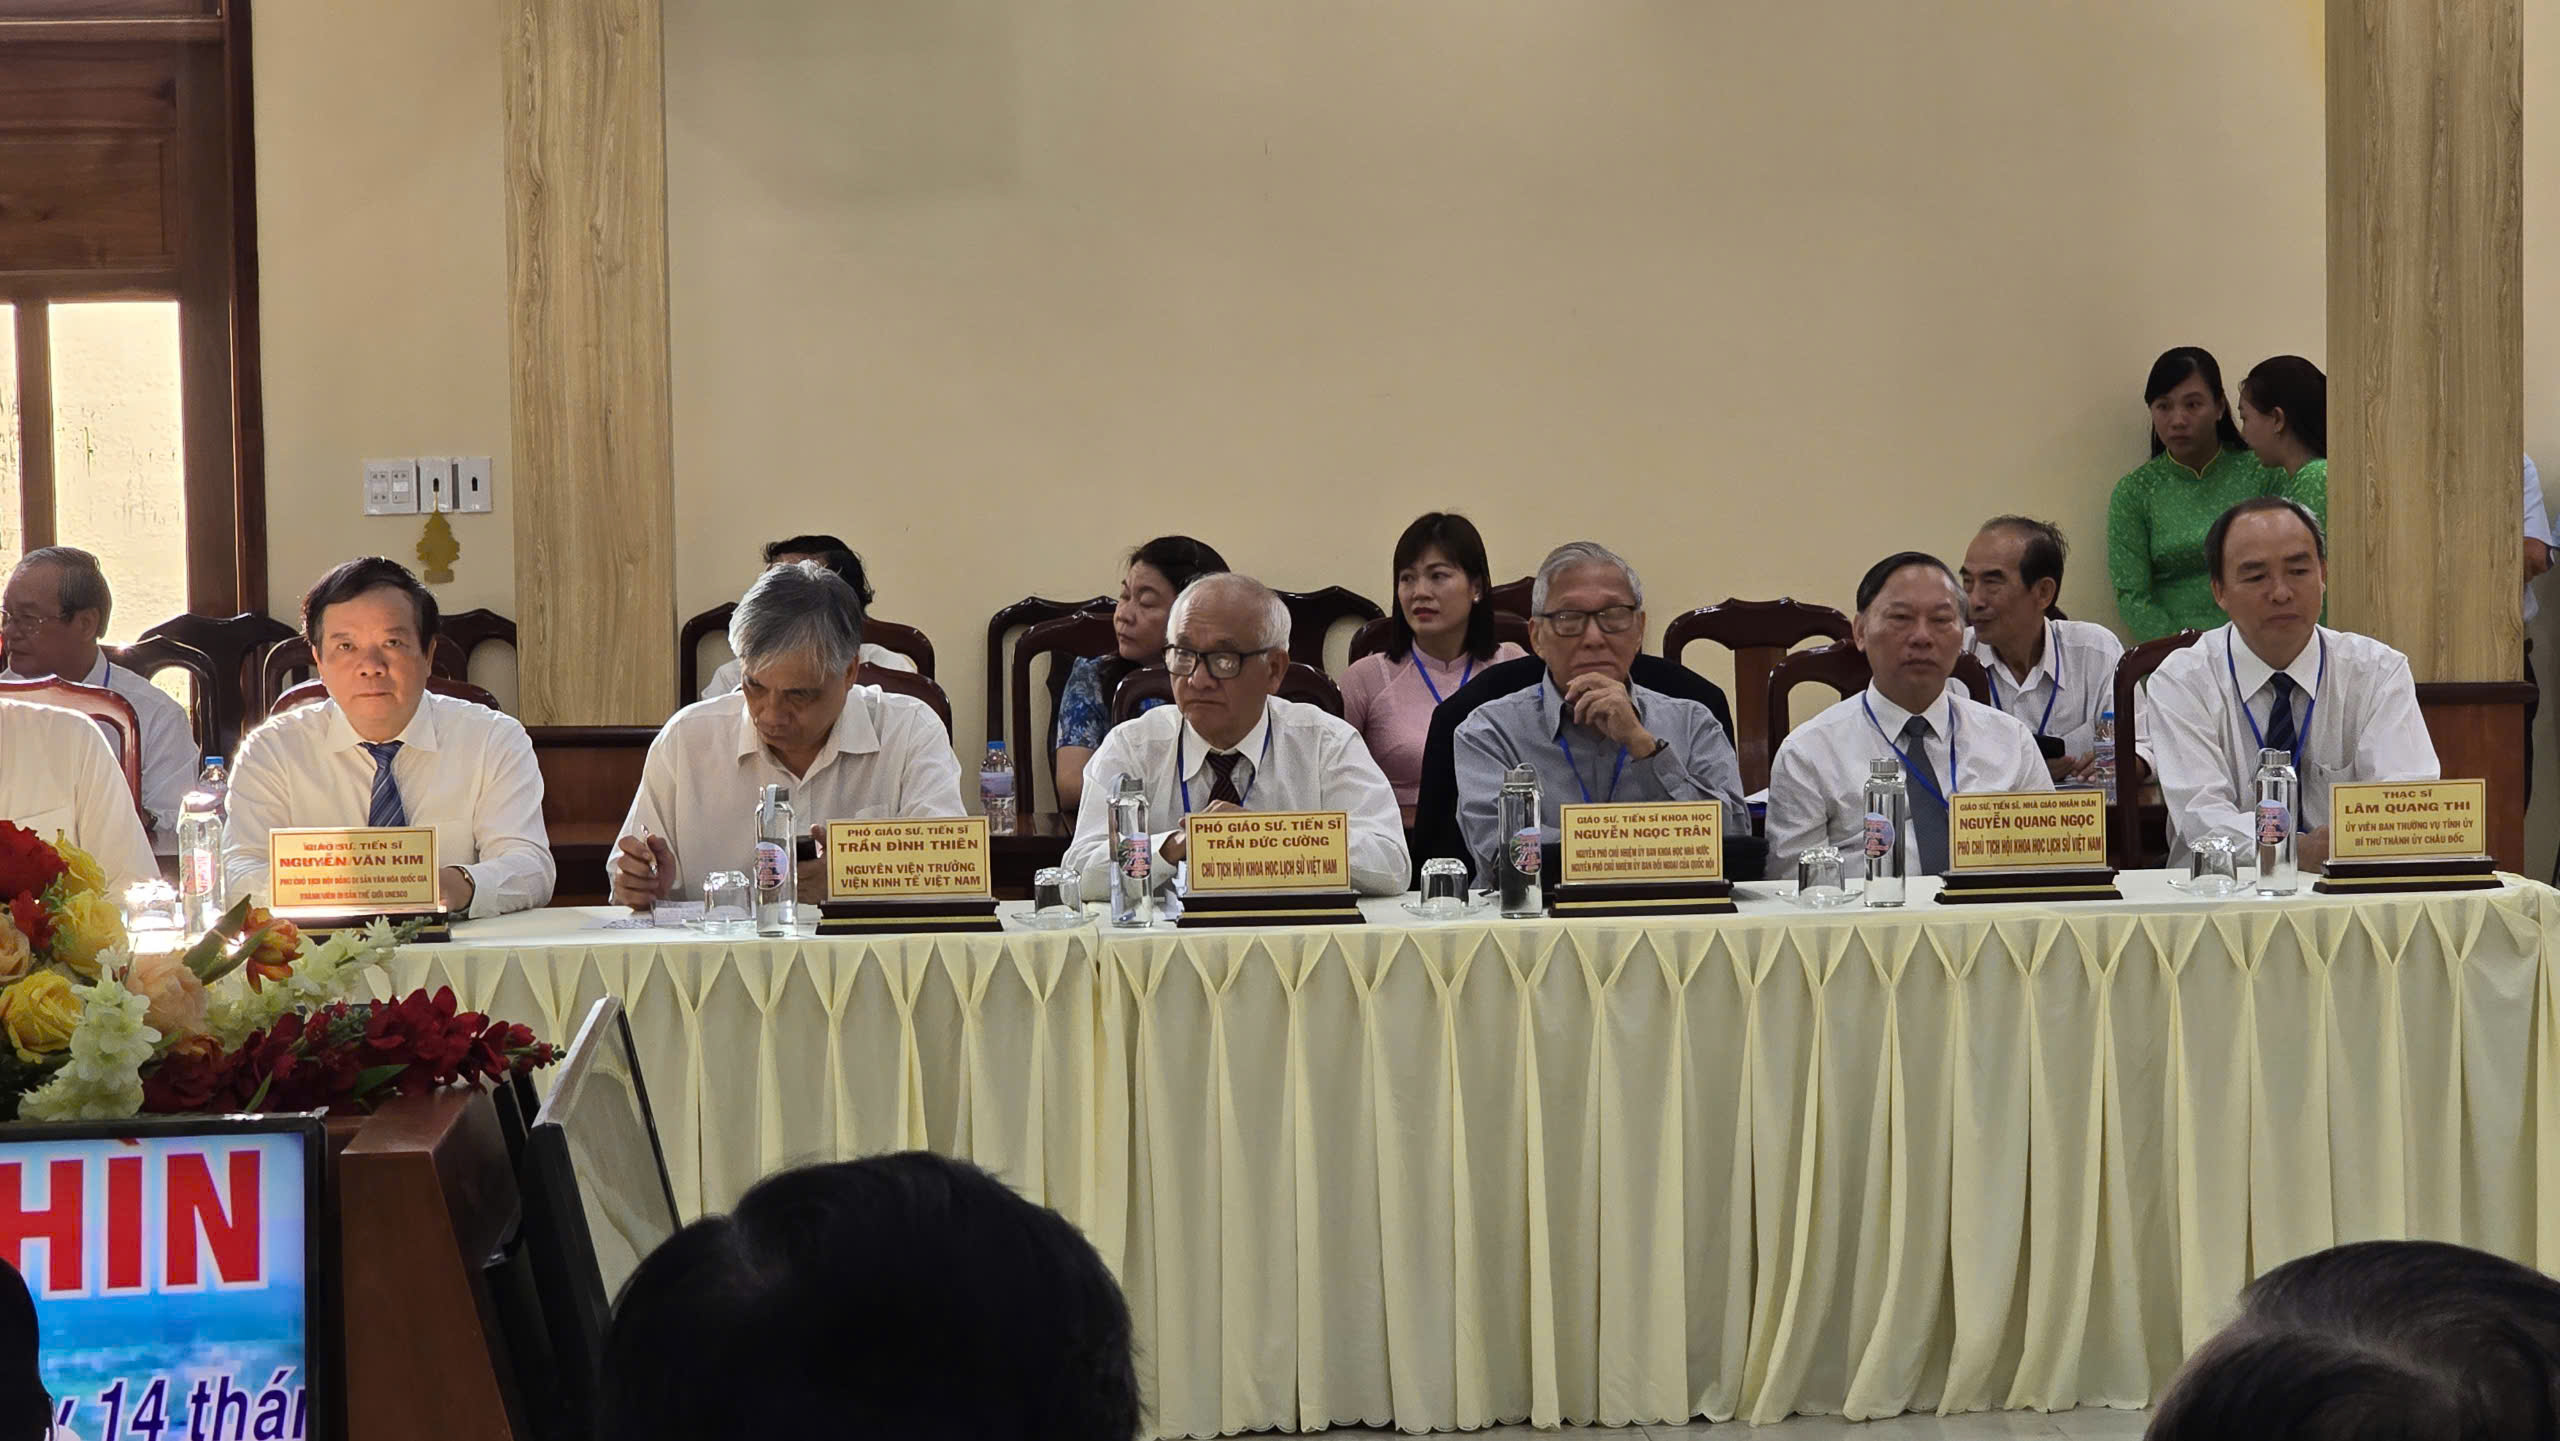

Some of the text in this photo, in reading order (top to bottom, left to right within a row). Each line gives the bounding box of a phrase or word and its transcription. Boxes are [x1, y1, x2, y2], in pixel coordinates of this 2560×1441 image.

[2382, 791, 2416, 800] THẠC
[1960, 802, 1977, 812] GIÁO
[1993, 800, 2010, 810] TIẾN
[2023, 800, 2038, 809] NHÀ
[2040, 799, 2057, 809] GIÁO
[2059, 798, 2079, 808] NHÂN
[2081, 798, 2096, 807] DÂN
[2345, 801, 2470, 815] LÂM QUANG THI
[1195, 817, 1342, 834] PHÓ GIÁO SƯ. TIẾN SĨ
[1577, 815, 1600, 824] GIÁO
[1622, 813, 1646, 823] TIẾN
[1661, 814, 1688, 822] KHOA
[1692, 813, 1712, 822] HỌC
[1960, 812, 2094, 829] NGUYỄN QUANG NGỌC
[2345, 821, 2356, 832] ỦY
[2359, 822, 2376, 832] VIÊN
[2379, 822, 2395, 831] BAN
[2397, 820, 2428, 830] THƯỜNG
[2429, 821, 2440, 831] VỤ
[2463, 817, 2473, 828] ỦY
[848, 828, 871, 837] PHÓ
[875, 827, 901, 836] GIÁO
[928, 824, 953, 835] TIẾN
[1574, 825, 1711, 840] NGUYỄN NGỌC TRÂN
[360, 840, 387, 850] TIẾN
[838, 838, 978, 853] TRẦN ĐÌNH THIÊN
[1207, 834, 1329, 849] TRẦN ĐỨC CƯỜNG
[1958, 832, 2102, 858] PHÓ CHỦ TỊCH HỘI KHOA HỌC LỊCH SỬ VIỆT NAM
[2355, 832, 2464, 847] BÍ THƯ THÀNH ỦY CHÂU ĐỐC
[280, 852, 424, 867] NGUYỄN VĂN KIM
[846, 860, 975, 876] NGUYÊN VIỆN TRƯỞNG
[1202, 854, 1337, 881] CHỦ TỊCH HỘI KHOA HỌC LỊCH SỬ VIỆT NAM
[841, 874, 980, 890] VIỆN KINH TẾ VIỆT NAM
[101, 1379, 166, 1441] 14
[190, 1370, 306, 1441] thá
